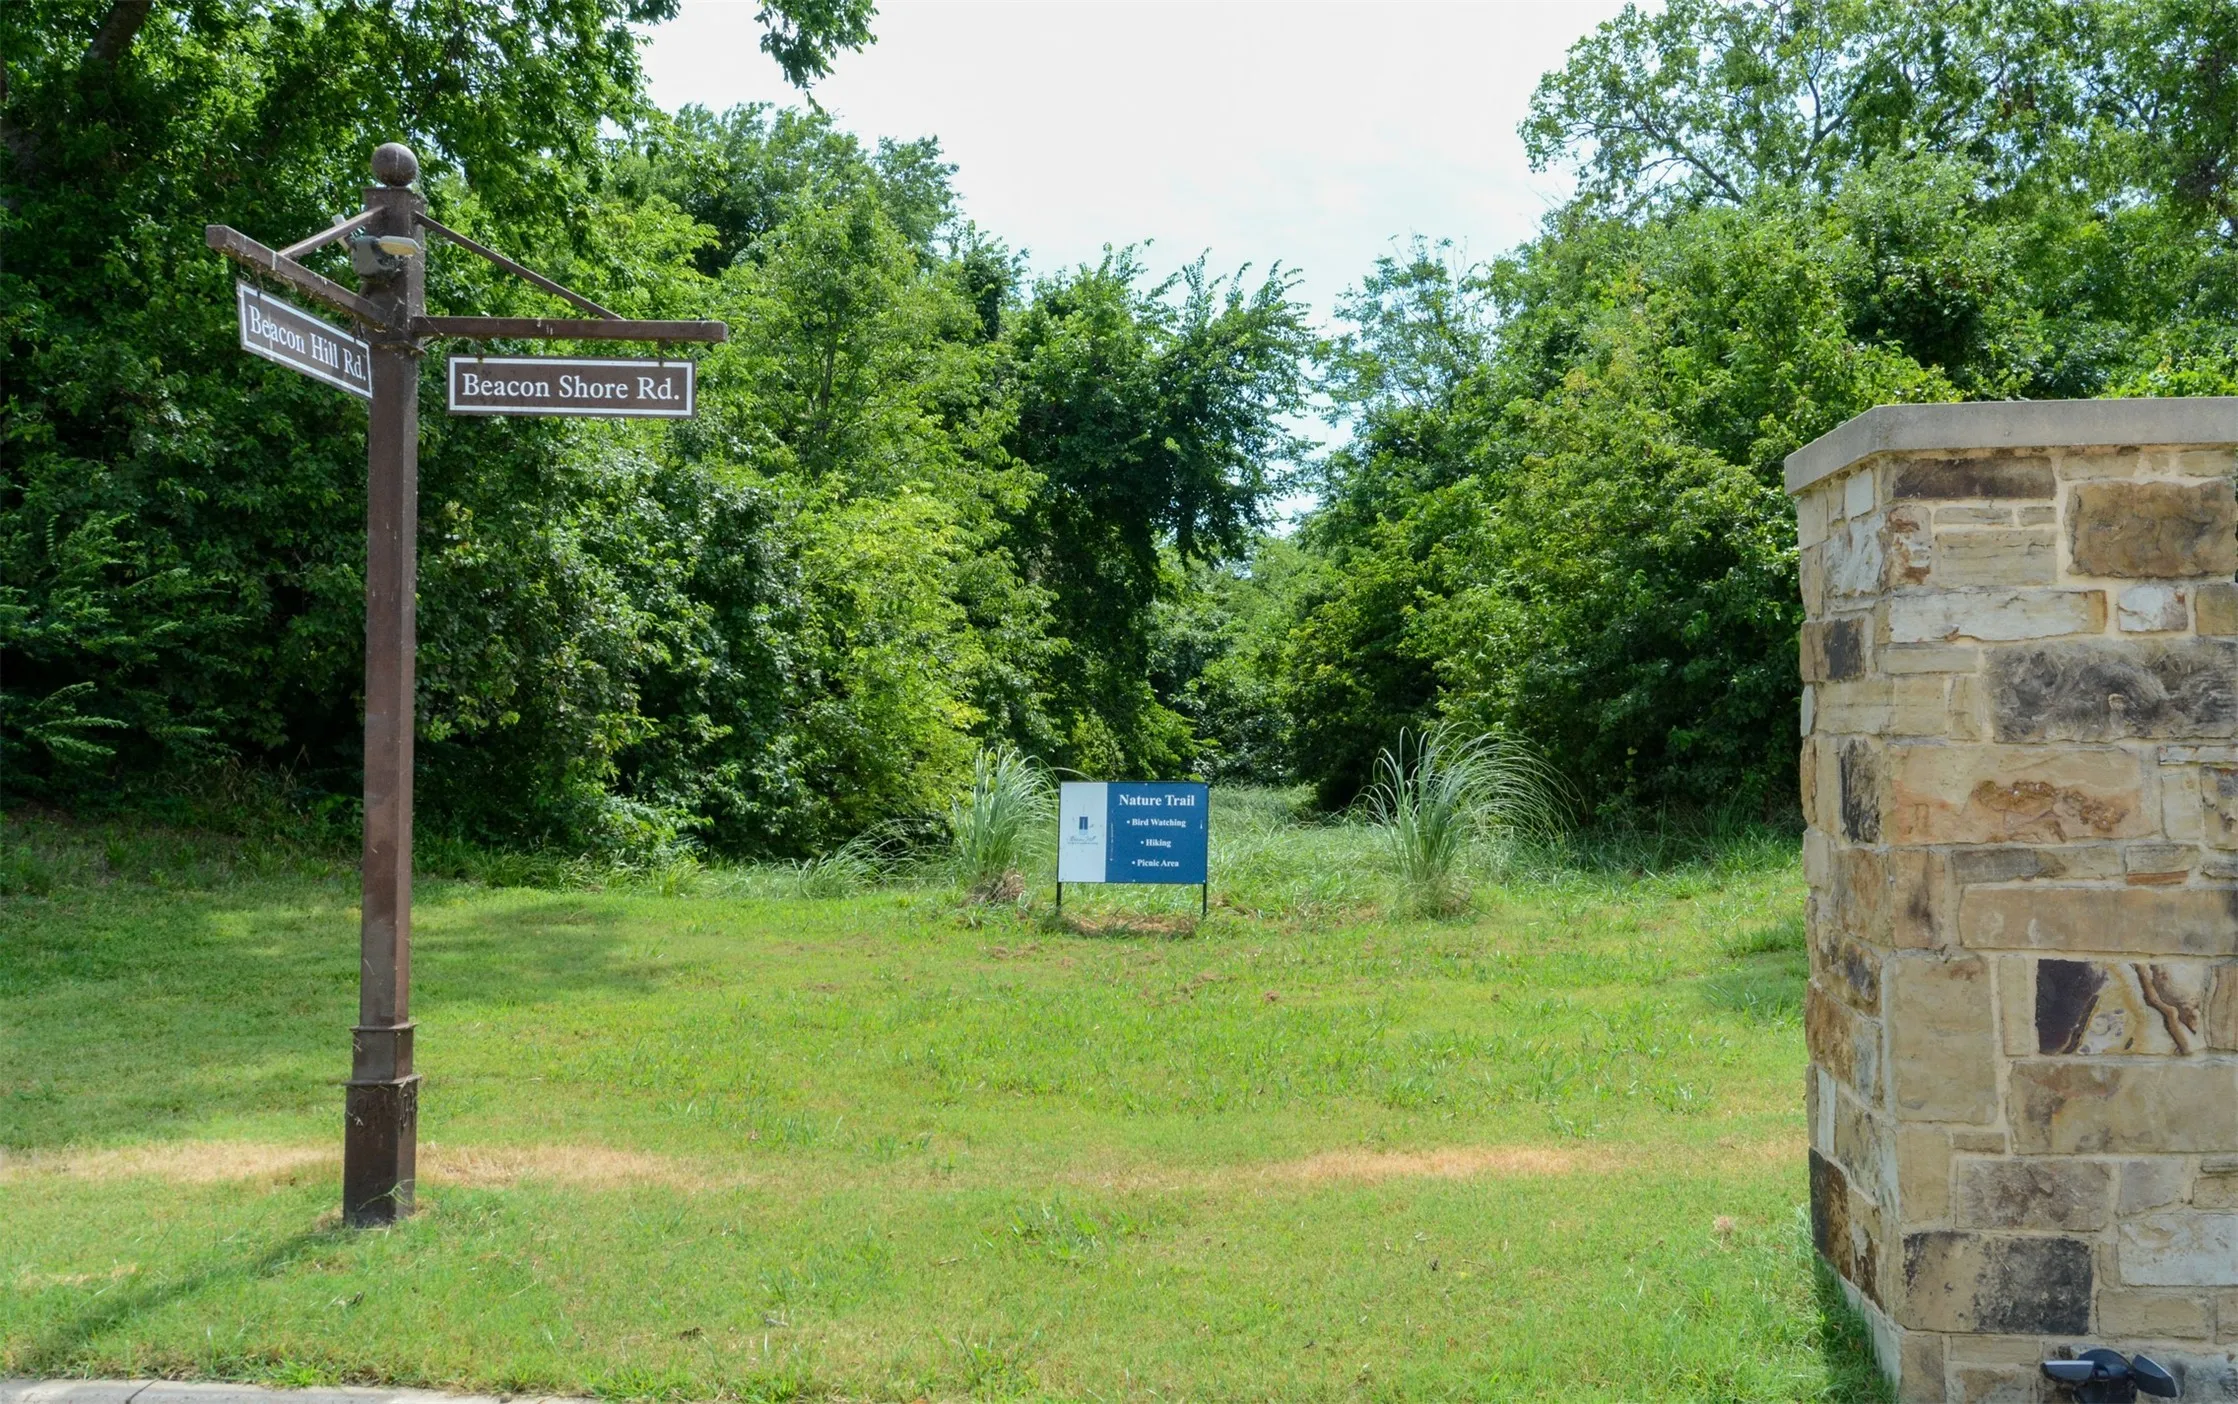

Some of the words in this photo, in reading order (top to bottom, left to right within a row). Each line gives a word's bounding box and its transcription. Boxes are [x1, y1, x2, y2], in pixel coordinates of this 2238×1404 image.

[248, 304, 306, 355] Beacon
[310, 332, 339, 369] Hill
[342, 347, 367, 381] Rd.
[461, 372, 551, 398] Beacon
[558, 374, 629, 399] Shore
[636, 376, 680, 400] Rd.
[1119, 794, 1162, 807] Nature
[1165, 794, 1195, 807] Trail
[1132, 818, 1149, 826] Bird
[1150, 818, 1187, 828] Watching
[1145, 838, 1172, 848] Hiking
[1137, 859, 1160, 867] Picnic
[1161, 859, 1179, 867] Area
